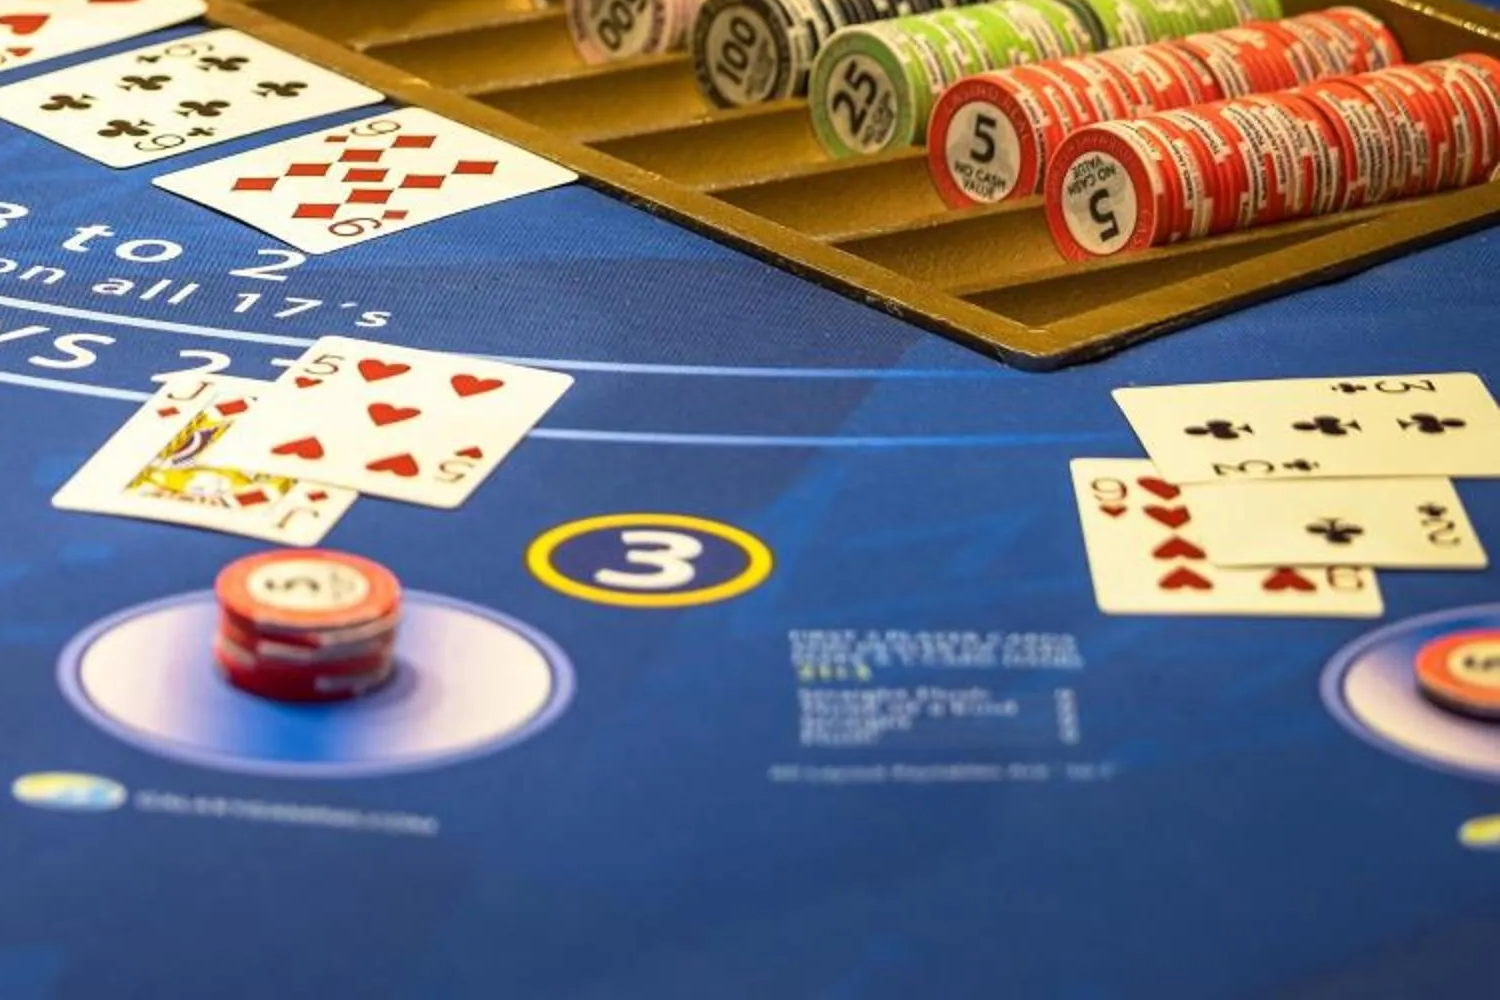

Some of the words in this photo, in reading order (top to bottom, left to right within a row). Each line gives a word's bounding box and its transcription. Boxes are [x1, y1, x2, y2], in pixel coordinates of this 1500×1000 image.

[715, 16, 757, 85] 100
[832, 60, 878, 135] 25
[970, 114, 997, 164] 5
[954, 160, 972, 177] NO
[975, 168, 1006, 190] CASH
[1097, 164, 1118, 182] NO
[1089, 188, 1120, 243] 5
[62, 222, 184, 262] to
[228, 249, 307, 281] 2
[92, 277, 200, 305] all
[150, 349, 232, 384] 2
[303, 354, 347, 376] 5
[432, 459, 476, 483] 5
[593, 530, 704, 590] 3
